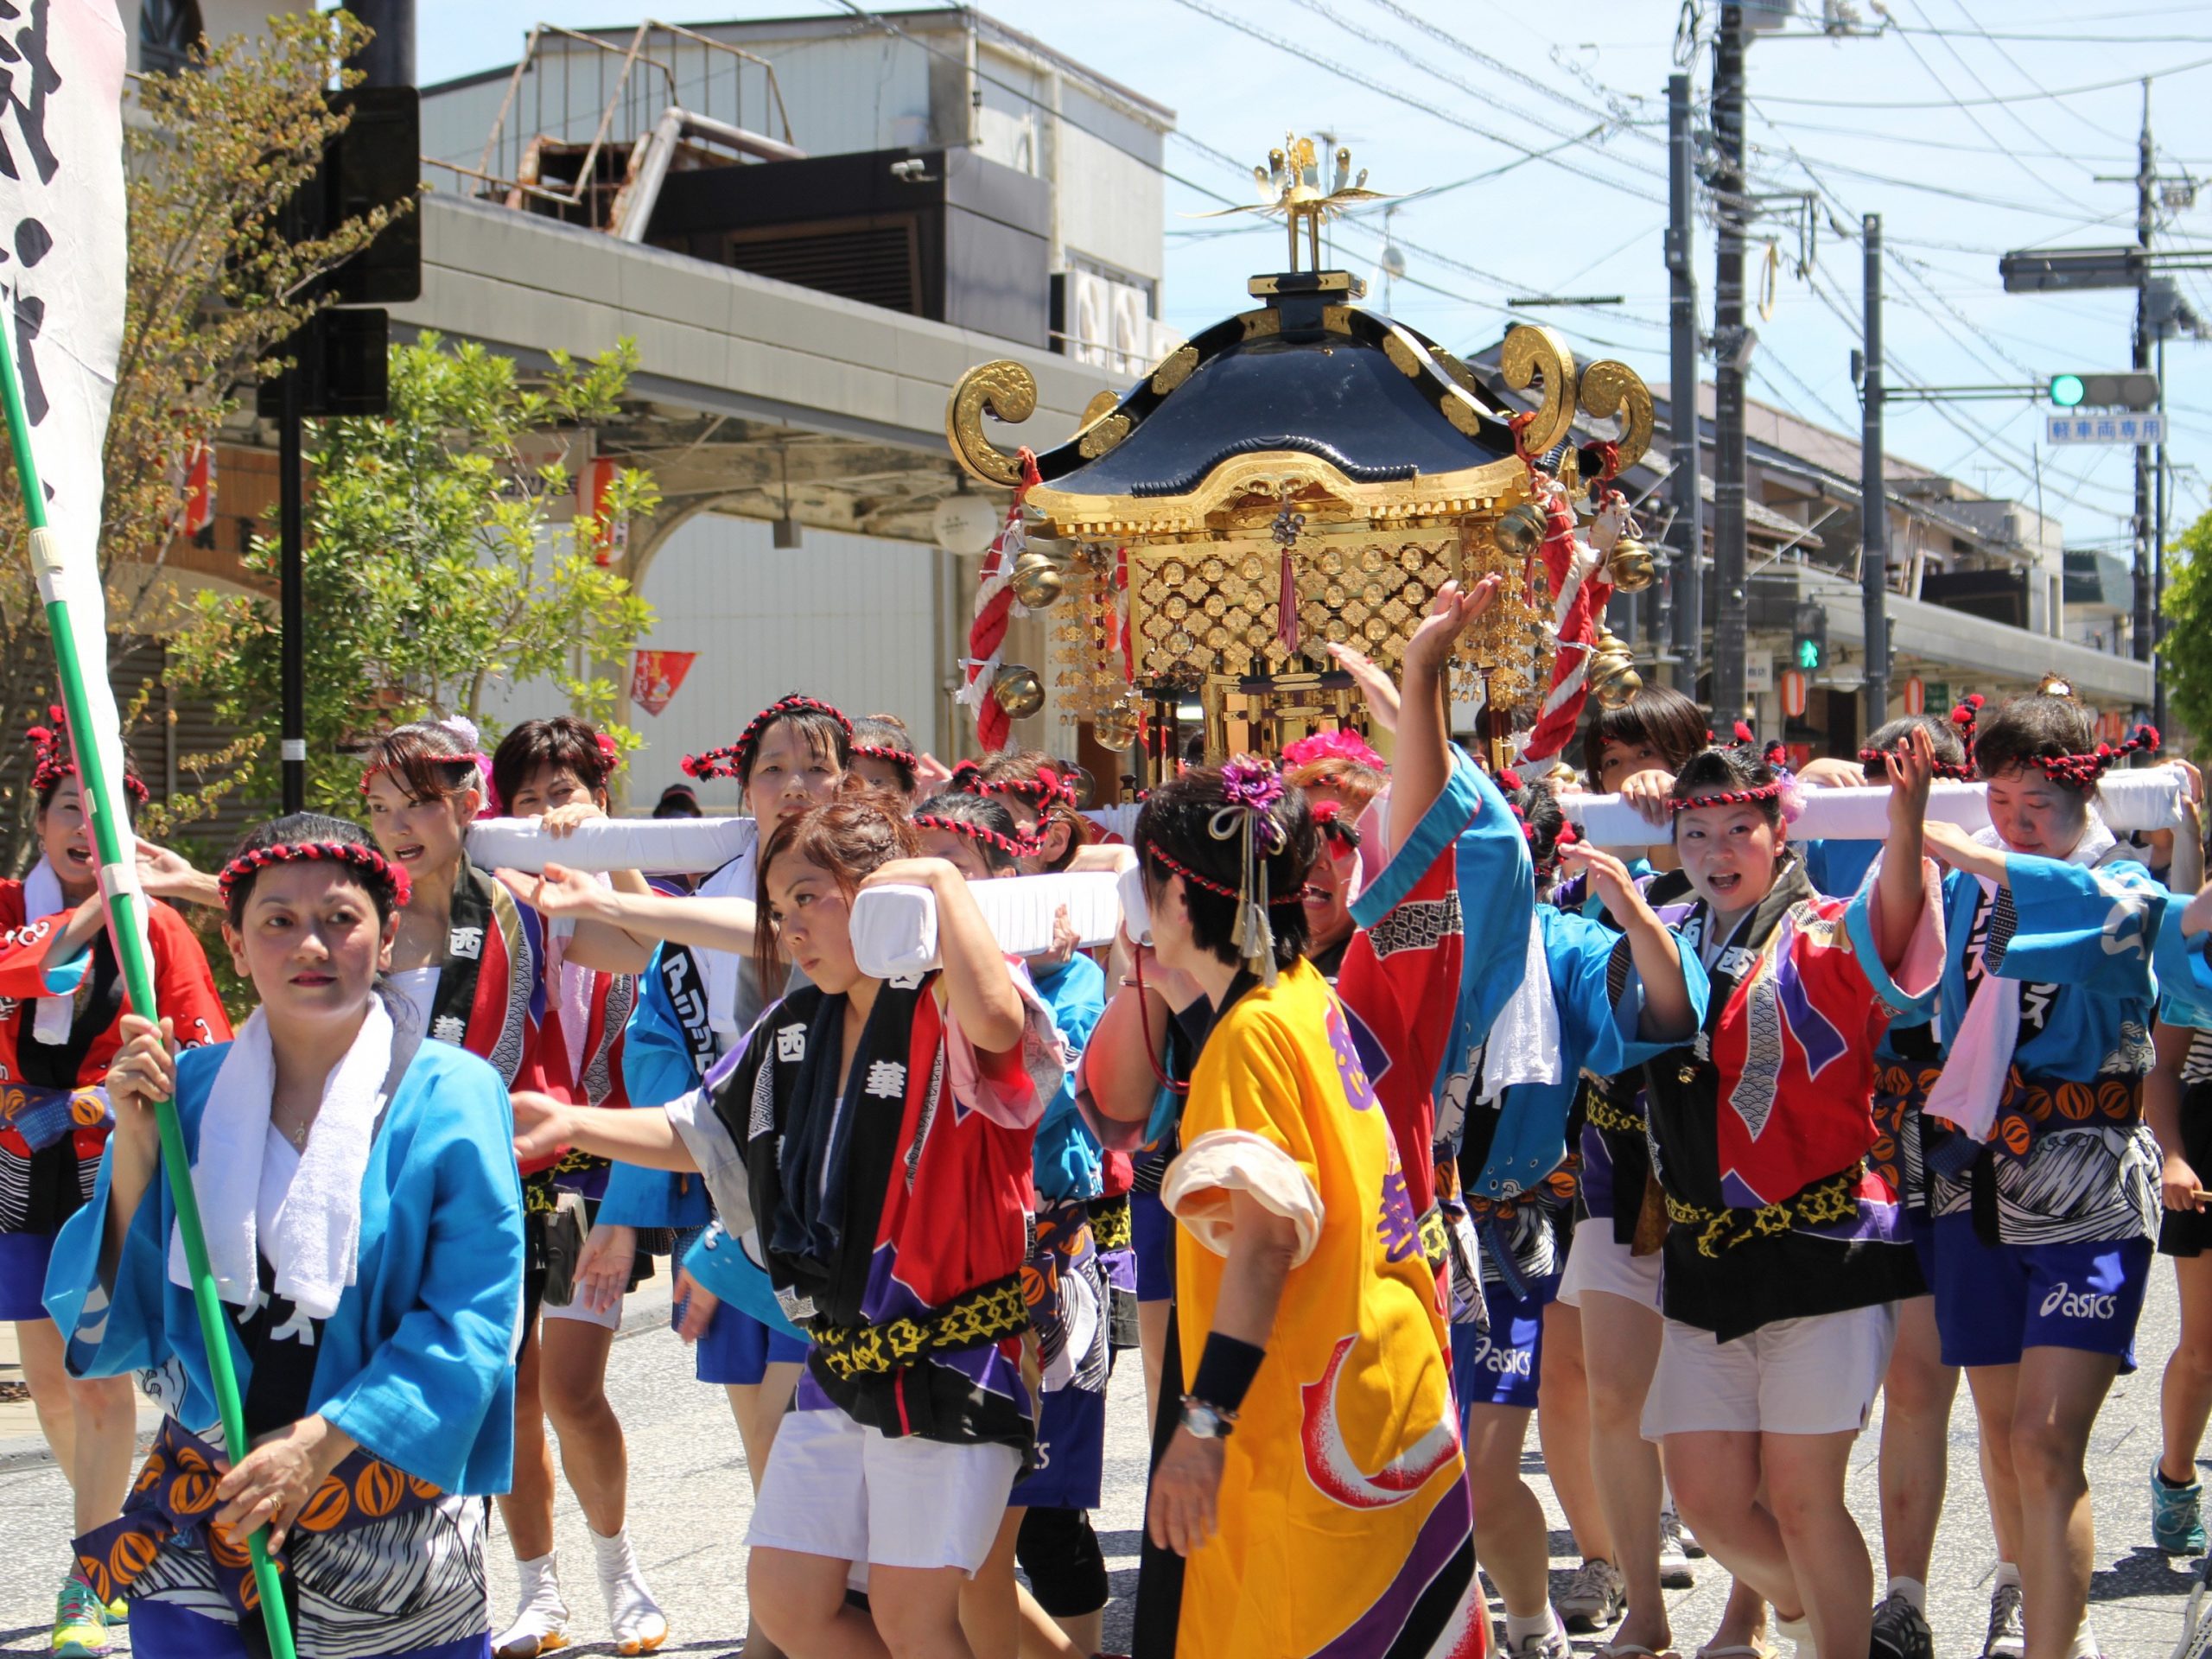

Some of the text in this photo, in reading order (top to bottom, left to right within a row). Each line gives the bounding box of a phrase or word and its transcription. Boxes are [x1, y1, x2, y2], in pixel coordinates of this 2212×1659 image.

[2053, 420, 2160, 440] 軽車両専用
[778, 1023, 807, 1062] 西
[865, 1060, 907, 1099] 華
[2062, 1293, 2118, 1319] asics
[1486, 1348, 1531, 1376] asics
